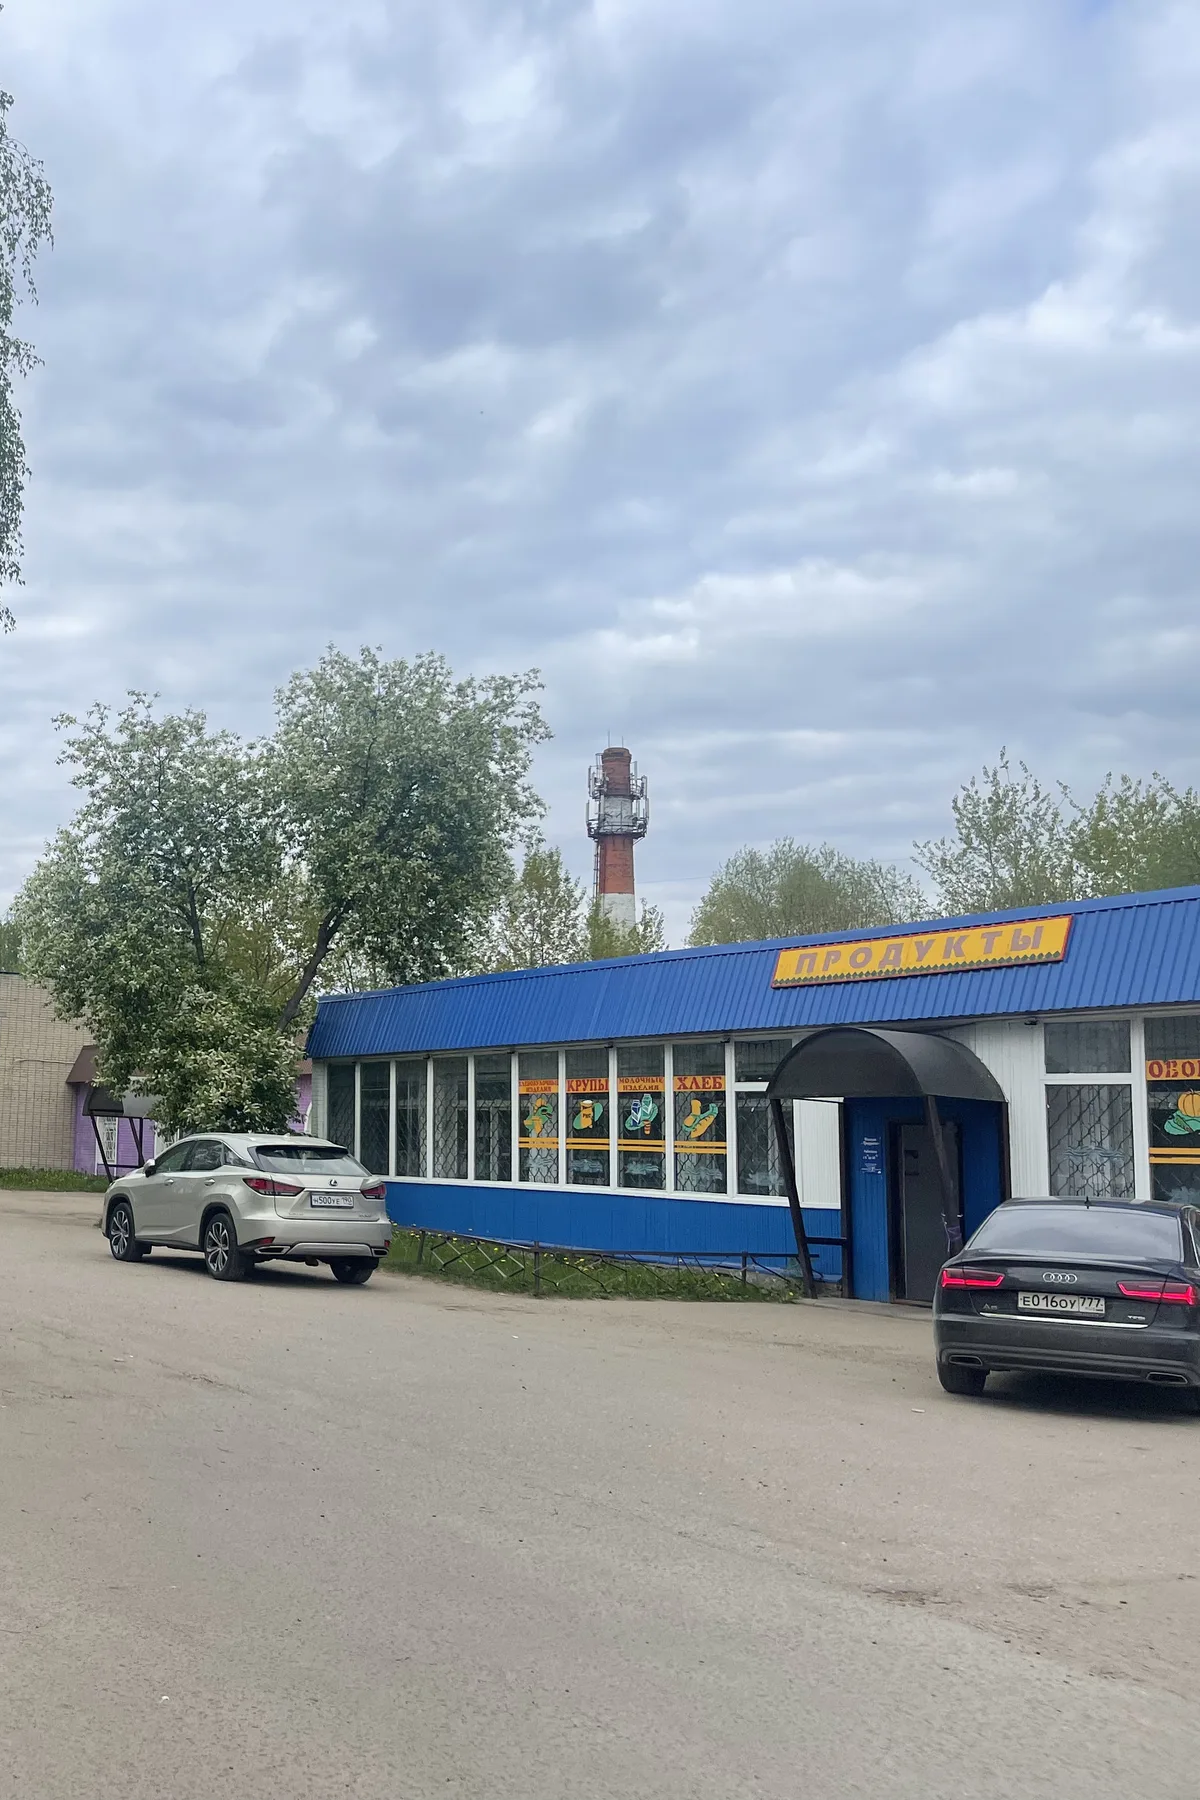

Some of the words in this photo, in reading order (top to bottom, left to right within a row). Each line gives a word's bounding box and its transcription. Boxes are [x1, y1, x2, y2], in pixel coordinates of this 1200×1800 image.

[794, 925, 1045, 975] ПРОДУКТЫ
[1148, 1060, 1200, 1078] ОВО
[566, 1079, 609, 1092] КРУПЫ
[619, 1076, 664, 1084] МОЛОЧНЫЕ
[676, 1076, 723, 1090] ХЛЕБ
[1079, 1296, 1101, 1308] 777
